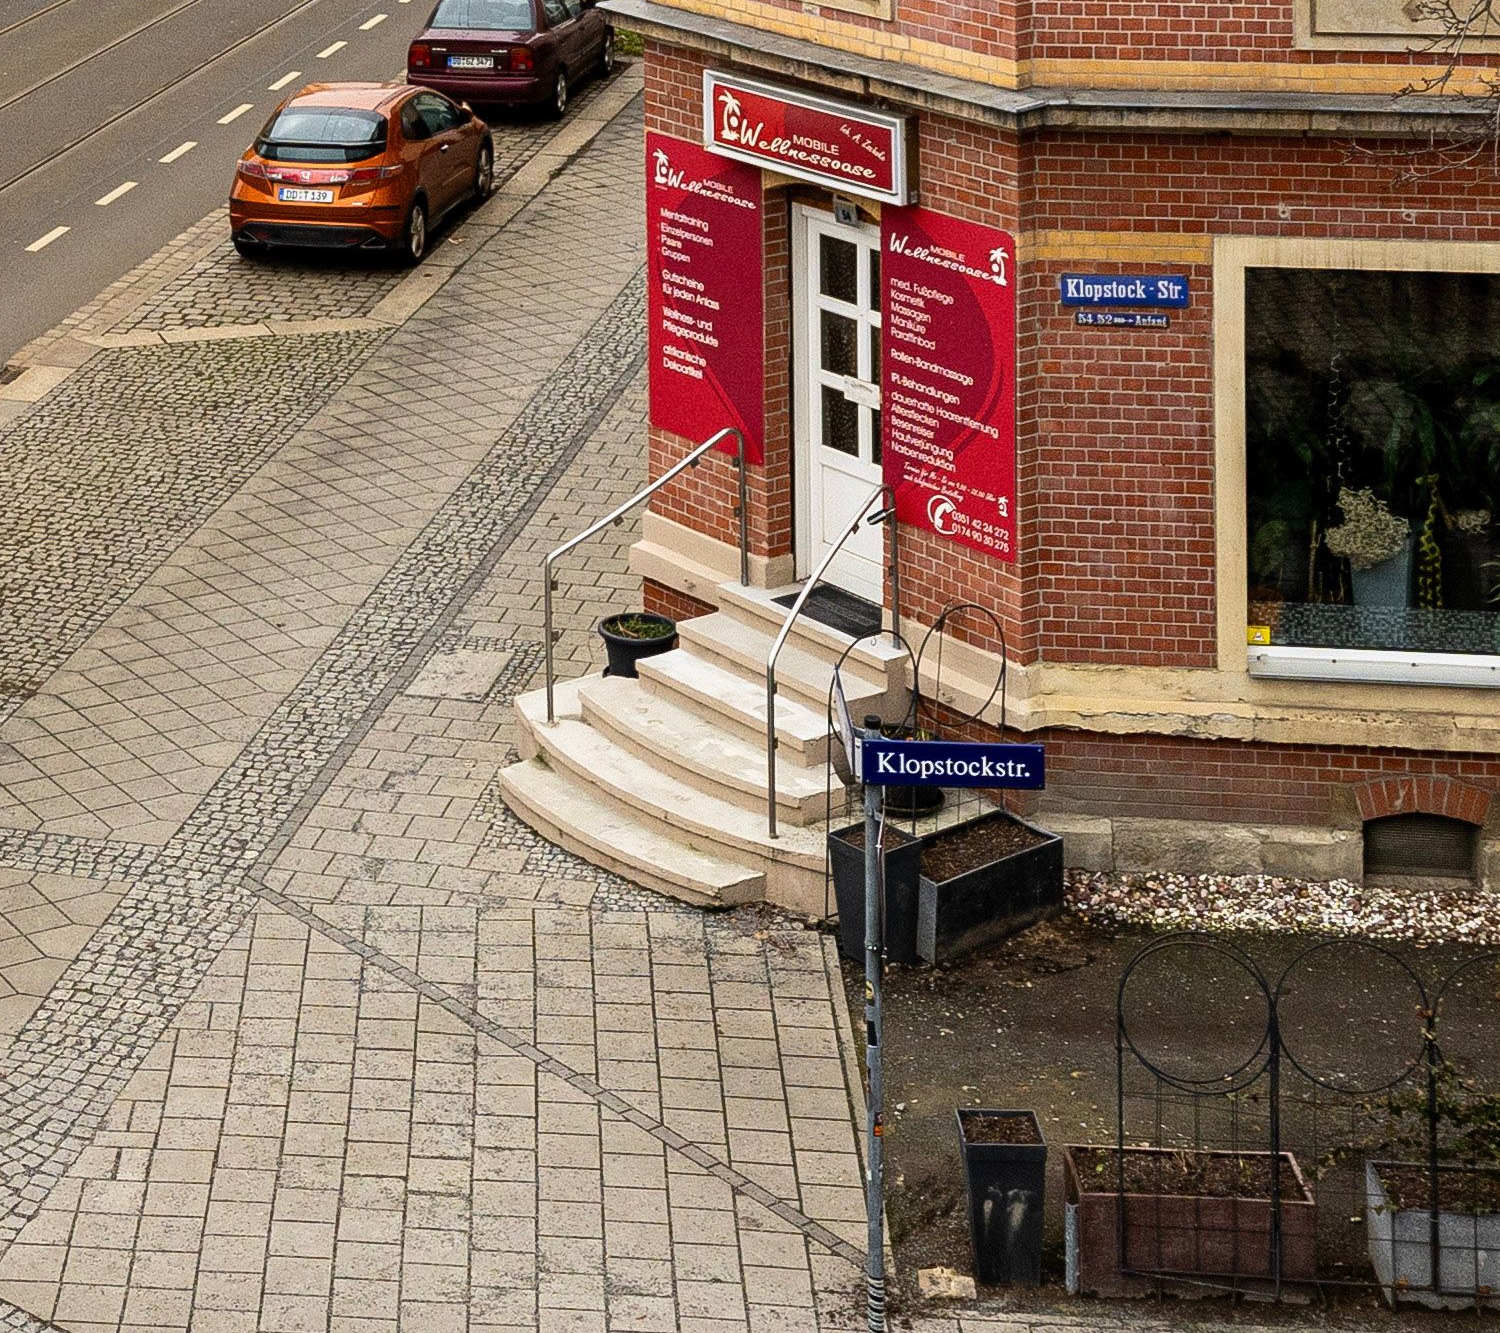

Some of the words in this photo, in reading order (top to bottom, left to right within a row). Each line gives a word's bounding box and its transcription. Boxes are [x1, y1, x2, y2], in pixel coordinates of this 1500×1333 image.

[740, 118, 876, 179] Wellnessoase
[792, 134, 840, 156] MOBILE
[311, 191, 328, 201] 139
[668, 168, 757, 209] Wellnessoase
[703, 179, 734, 194] MOBILE
[661, 207, 709, 232] Mentaltraining
[661, 222, 714, 247] Einzelpersonen
[661, 234, 682, 249] Paare
[662, 246, 691, 263] Gruppen
[889, 232, 993, 280] Wellnessoase
[930, 244, 966, 263] MOBILE
[662, 269, 705, 291] Gutscheine
[662, 282, 672, 294] für
[673, 286, 695, 302] jeden
[890, 277, 912, 292] med.
[913, 283, 954, 305] Fußpflege
[1066, 278, 1147, 302] Klopstock
[1157, 280, 1185, 299] Str.
[891, 289, 925, 308] Kosmetik
[891, 301, 932, 323] Massagen
[891, 314, 926, 334] Maniküre
[663, 319, 719, 347] Pflegeprodukte
[697, 319, 713, 331] und
[891, 326, 936, 350] Paraffinbad
[891, 348, 974, 386] Rollen-Bandmassage
[891, 372, 960, 405] IPL-Behandlungen
[891, 391, 935, 413] dauerhafte
[936, 405, 999, 439] Haarentfernung
[891, 403, 939, 428] Altersflecken
[891, 415, 935, 439] Besenreiser
[892, 428, 954, 461] Hautverjüngung
[892, 441, 957, 473] Narbenreduktion
[951, 522, 971, 537] 0174
[971, 530, 982, 542] 90
[971, 519, 982, 530] 42
[983, 522, 993, 534] 24
[994, 527, 1009, 541] 272
[876, 751, 1031, 779] Klopstockstr.
